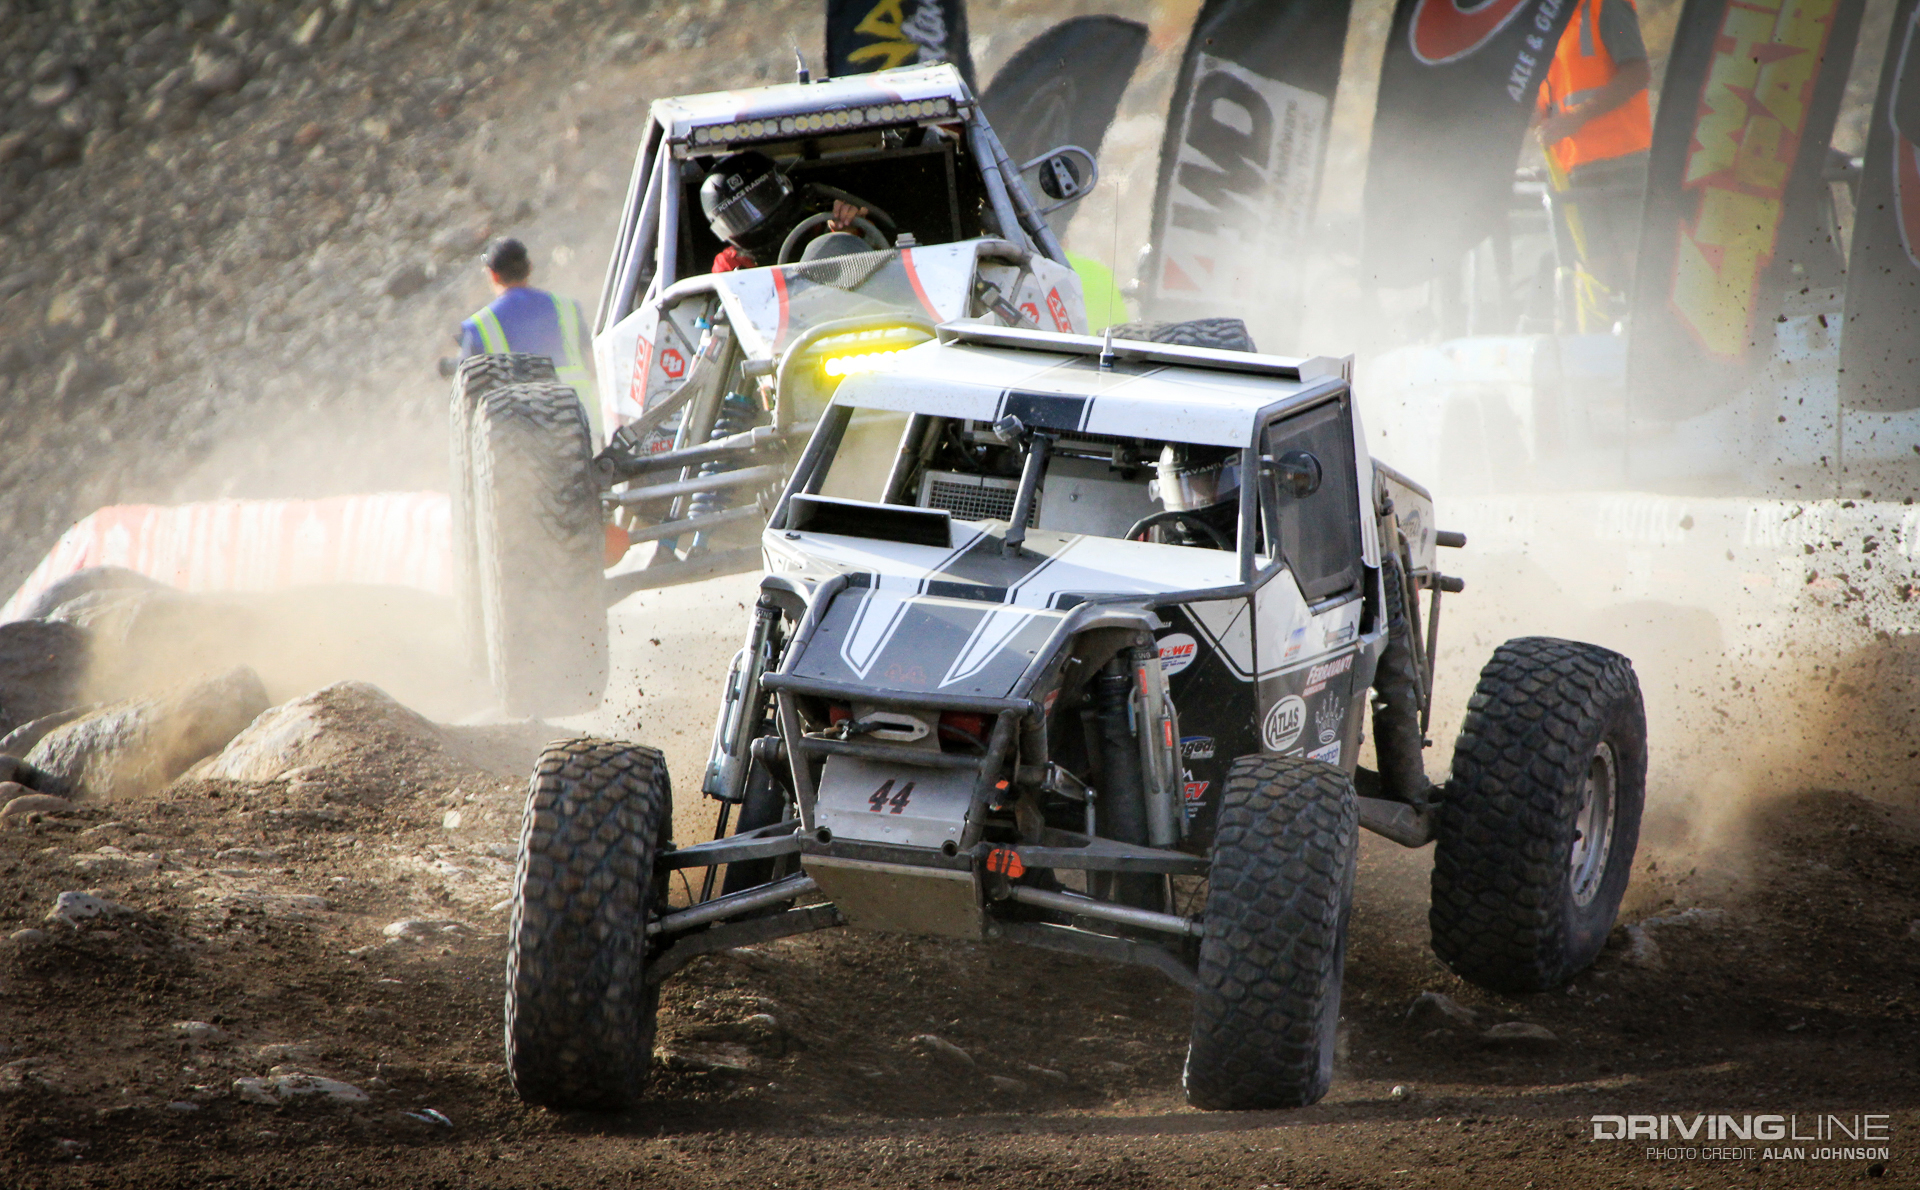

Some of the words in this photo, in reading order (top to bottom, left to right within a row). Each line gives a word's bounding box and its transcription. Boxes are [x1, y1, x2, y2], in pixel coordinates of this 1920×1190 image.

[1507, 51, 1536, 102] AXLE
[1526, 33, 1544, 51] &
[1686, 0, 1781, 183] WH
[727, 188, 746, 205] RACE
[1673, 187, 1780, 354] 4
[1268, 706, 1300, 739] ATLAS
[868, 779, 916, 815] 44
